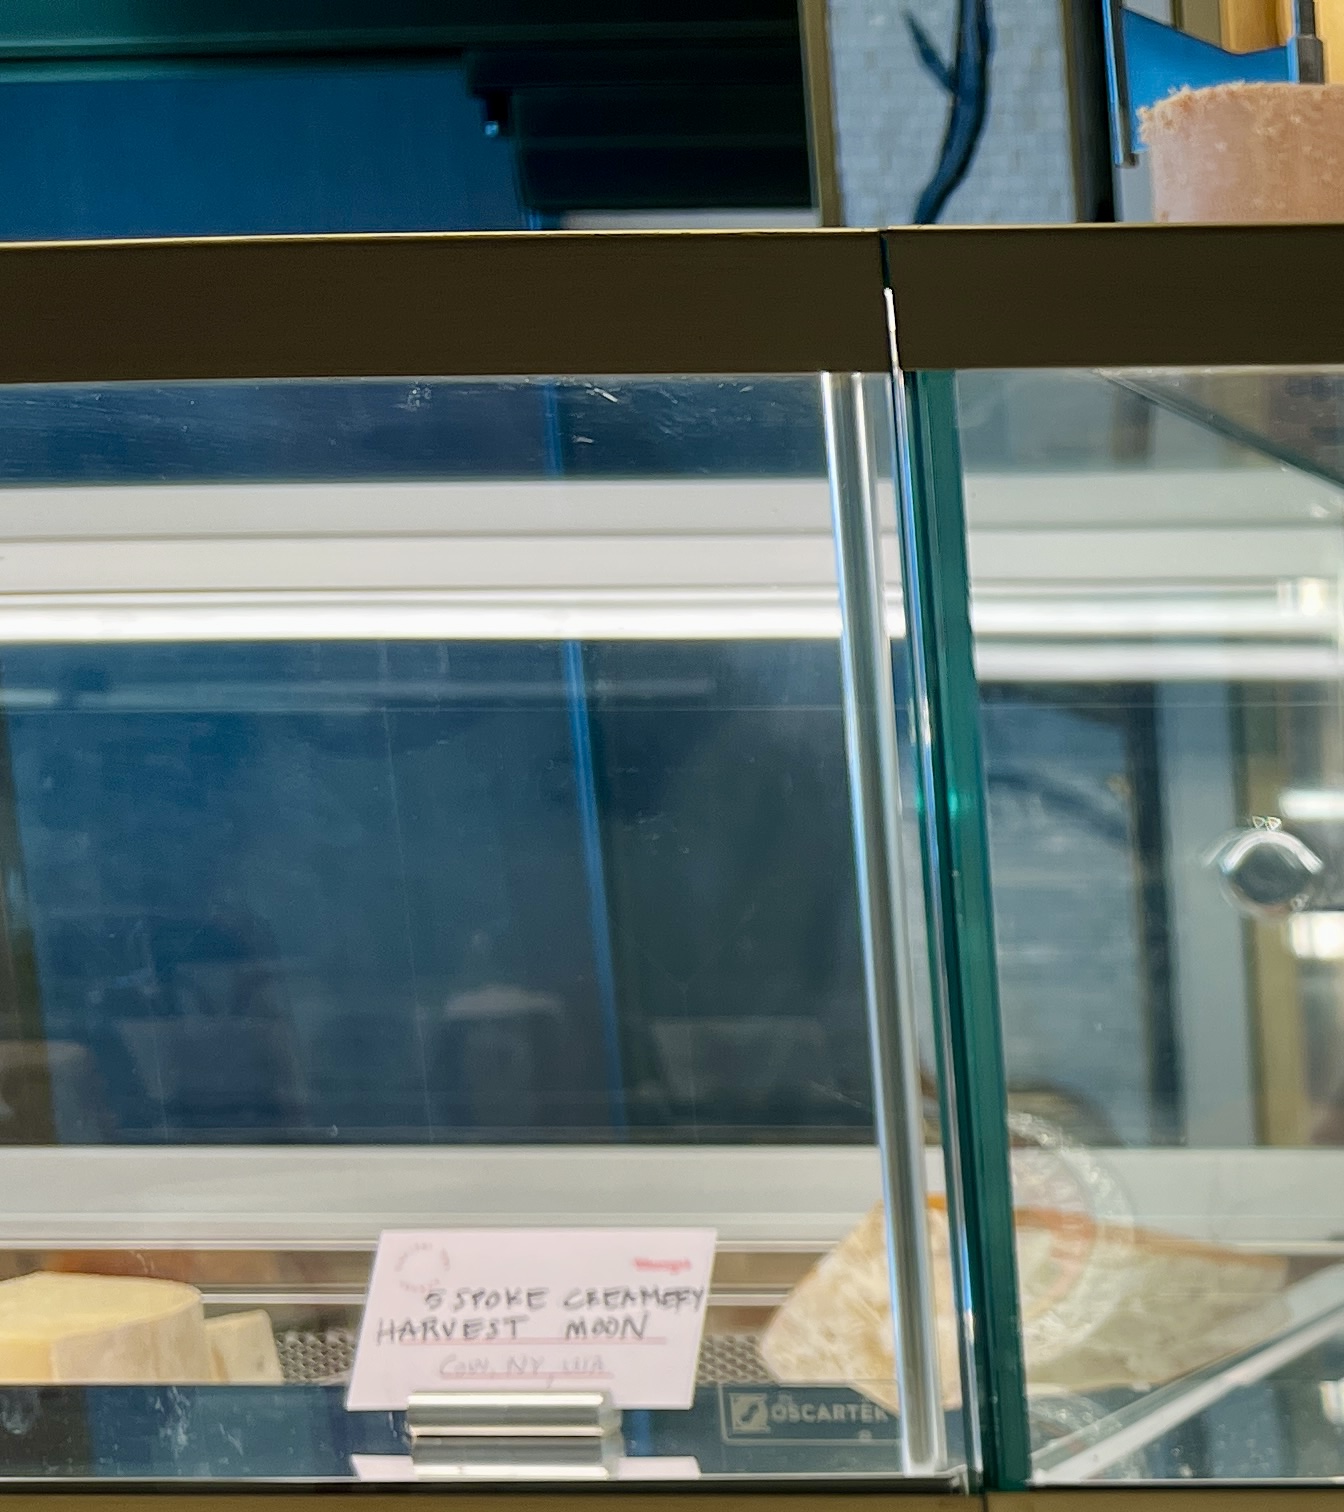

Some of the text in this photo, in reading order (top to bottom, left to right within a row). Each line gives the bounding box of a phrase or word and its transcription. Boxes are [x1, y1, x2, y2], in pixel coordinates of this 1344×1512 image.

[452, 1287, 549, 1312] SPOKE
[377, 1311, 650, 1346] HARVEST MOON
